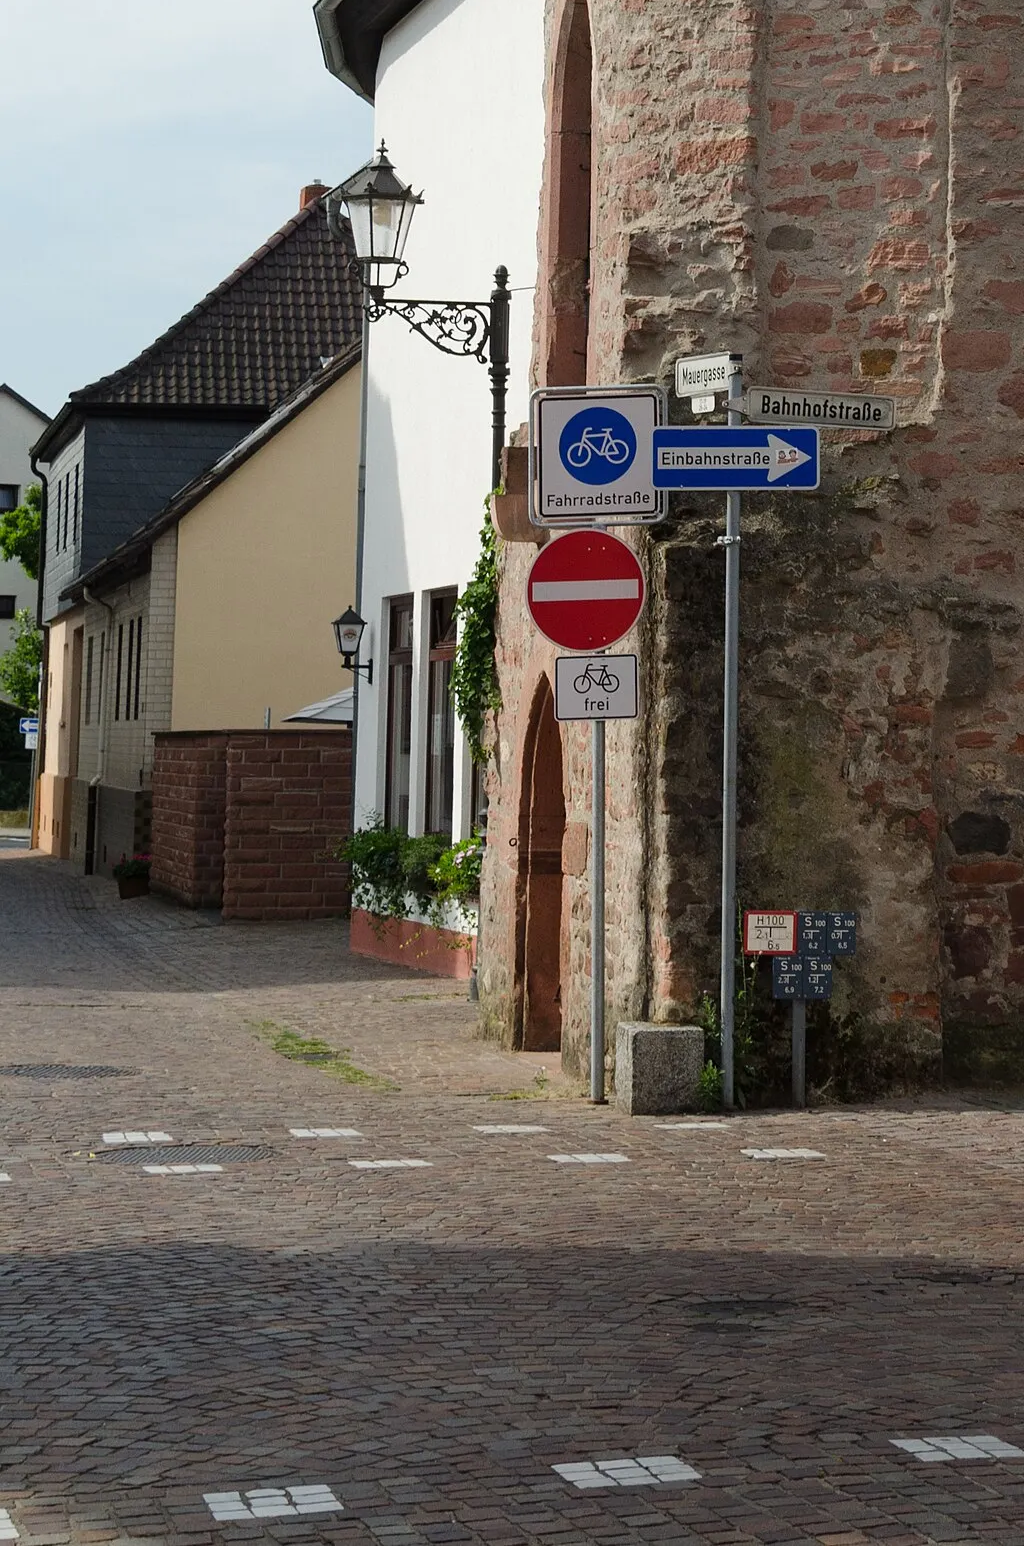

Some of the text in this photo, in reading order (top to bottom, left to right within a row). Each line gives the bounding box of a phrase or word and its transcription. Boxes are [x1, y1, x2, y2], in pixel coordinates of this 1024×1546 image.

[682, 366, 726, 387] Mauergasse
[761, 395, 882, 421] Bahnhofstraße
[661, 452, 771, 466] Einbahnstraße
[547, 491, 651, 507] Fahrradstraße
[584, 697, 609, 711] frei
[804, 916, 827, 927] S 100
[834, 916, 856, 927] S 100
[780, 960, 789, 971] S
[810, 960, 818, 971] S
